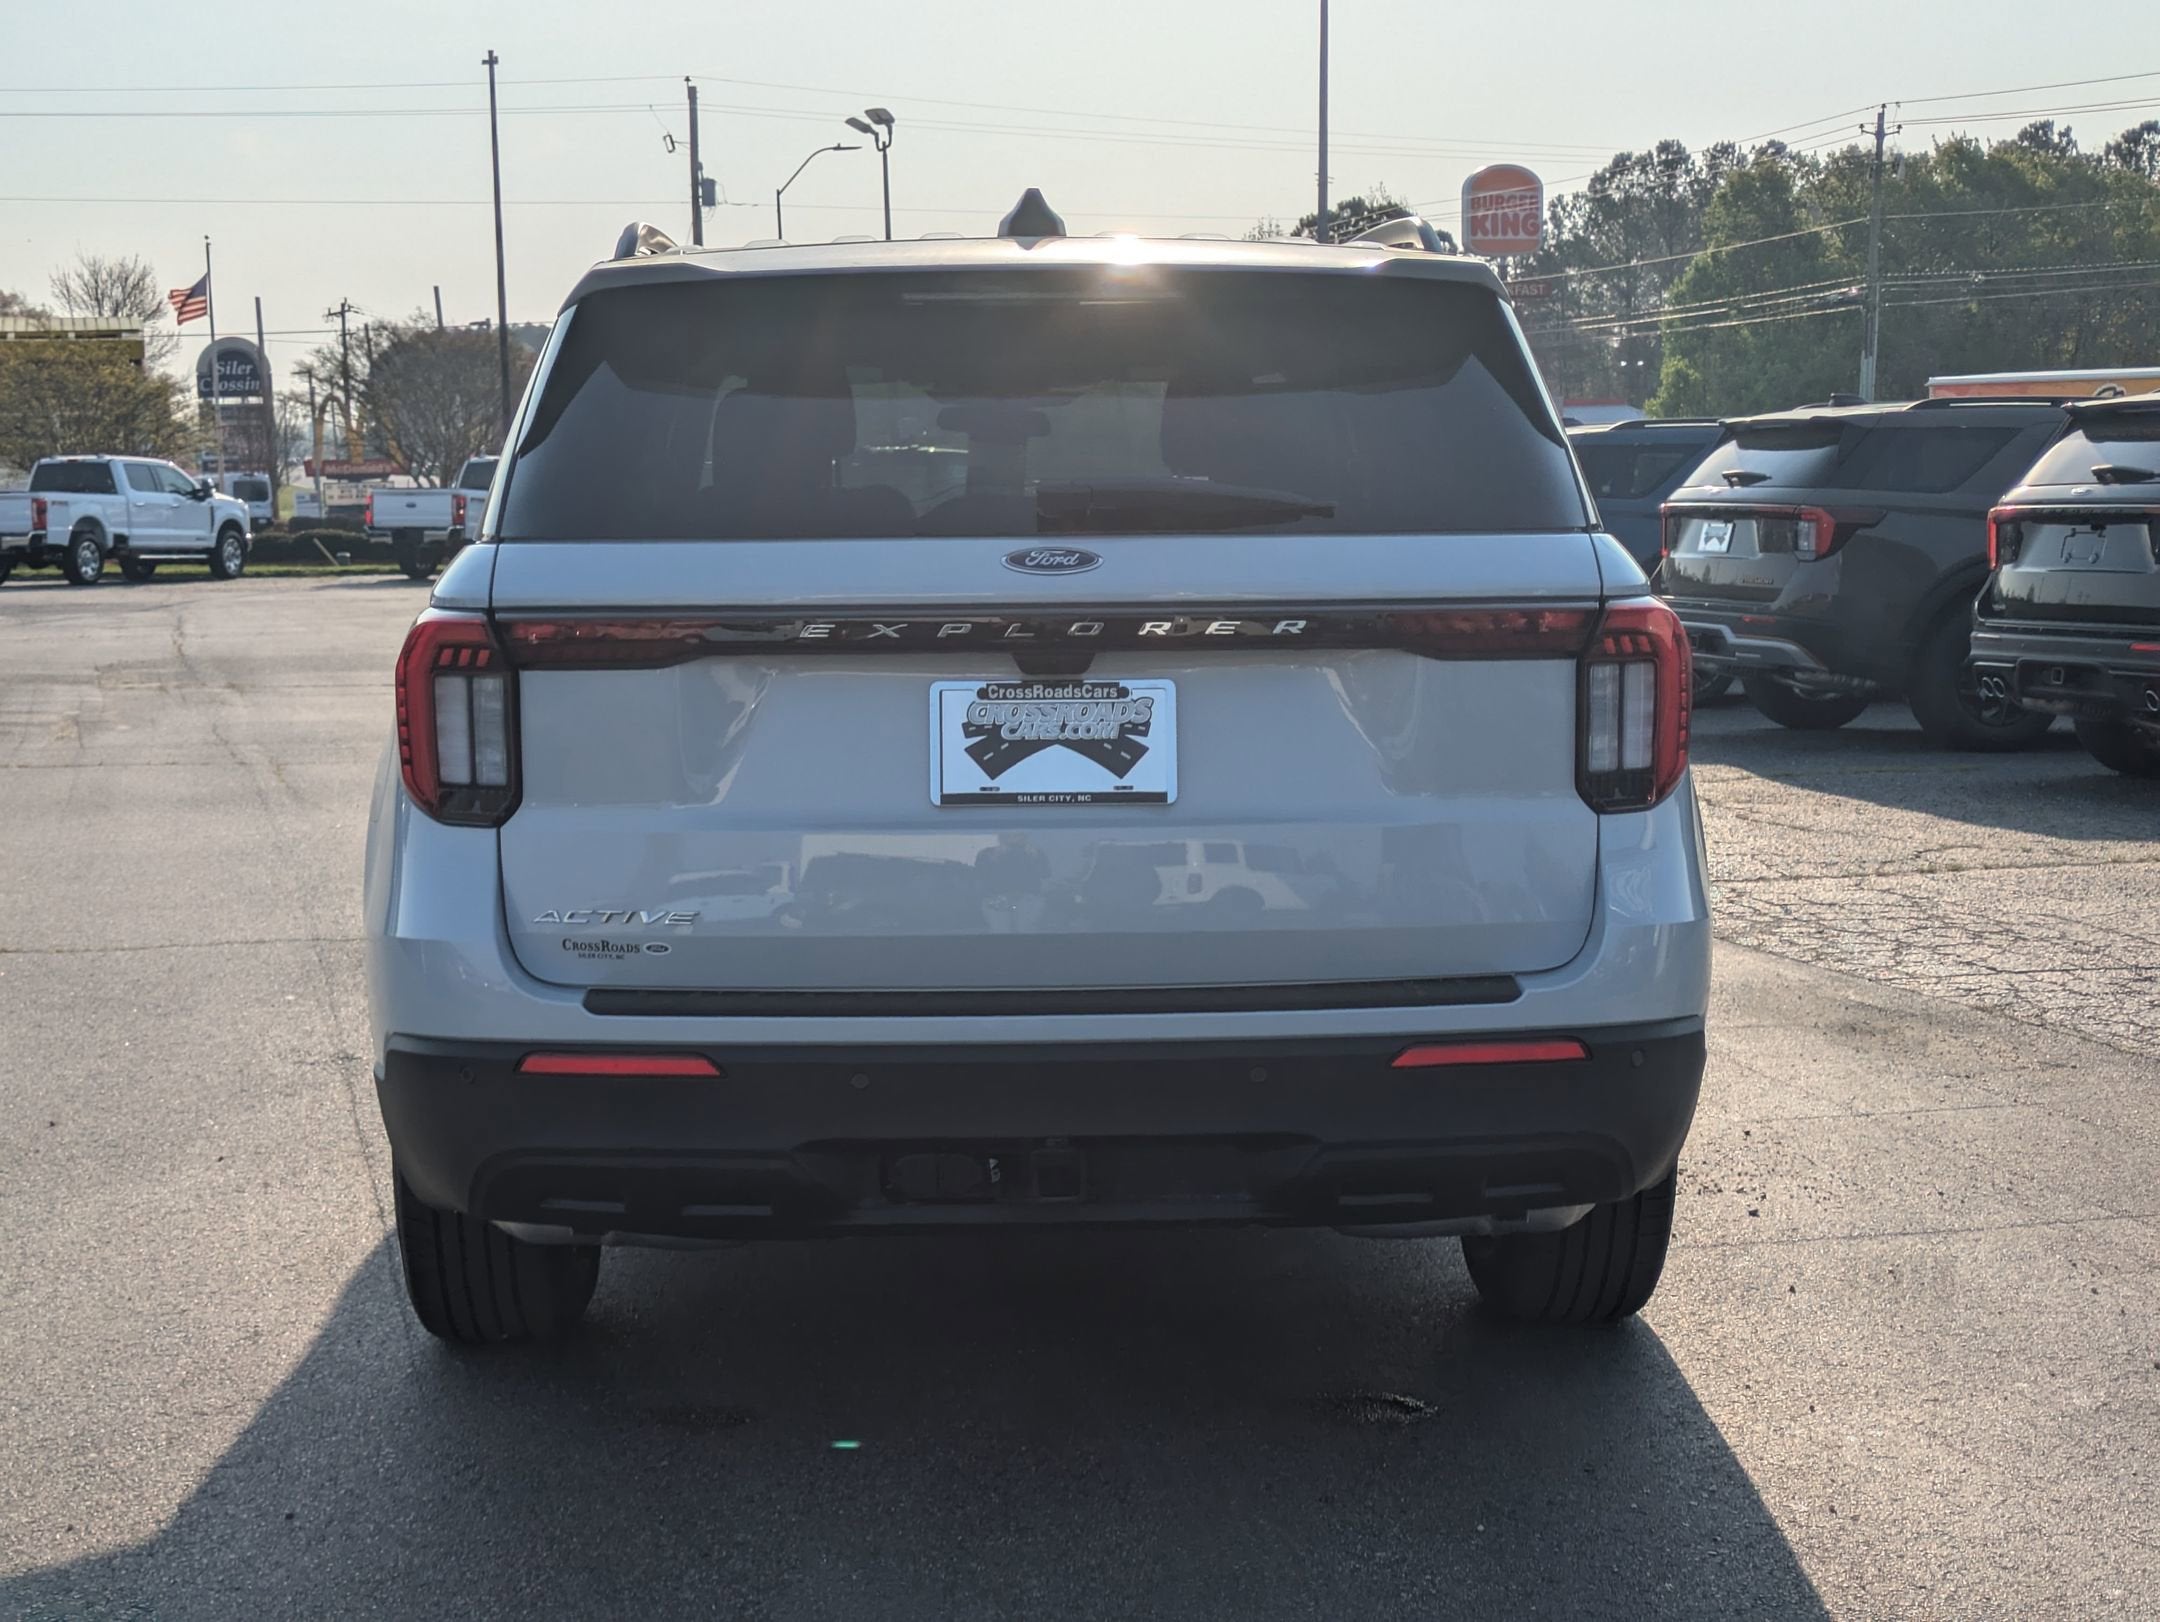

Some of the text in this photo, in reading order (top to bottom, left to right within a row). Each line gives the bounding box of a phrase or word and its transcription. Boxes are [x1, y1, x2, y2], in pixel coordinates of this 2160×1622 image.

[1470, 212, 1540, 237] KING
[216, 360, 253, 375] Siler
[200, 377, 260, 391] Cossin
[1025, 549, 1080, 568] Ford
[799, 619, 1307, 639] EXPLORER
[987, 684, 1118, 699] CrossRoadsCars
[967, 697, 1154, 725] CROSSROADS
[1001, 722, 1120, 740] CARS.COM
[1017, 794, 1092, 803] SILER CITY, NC
[533, 909, 700, 925] ACTIVE
